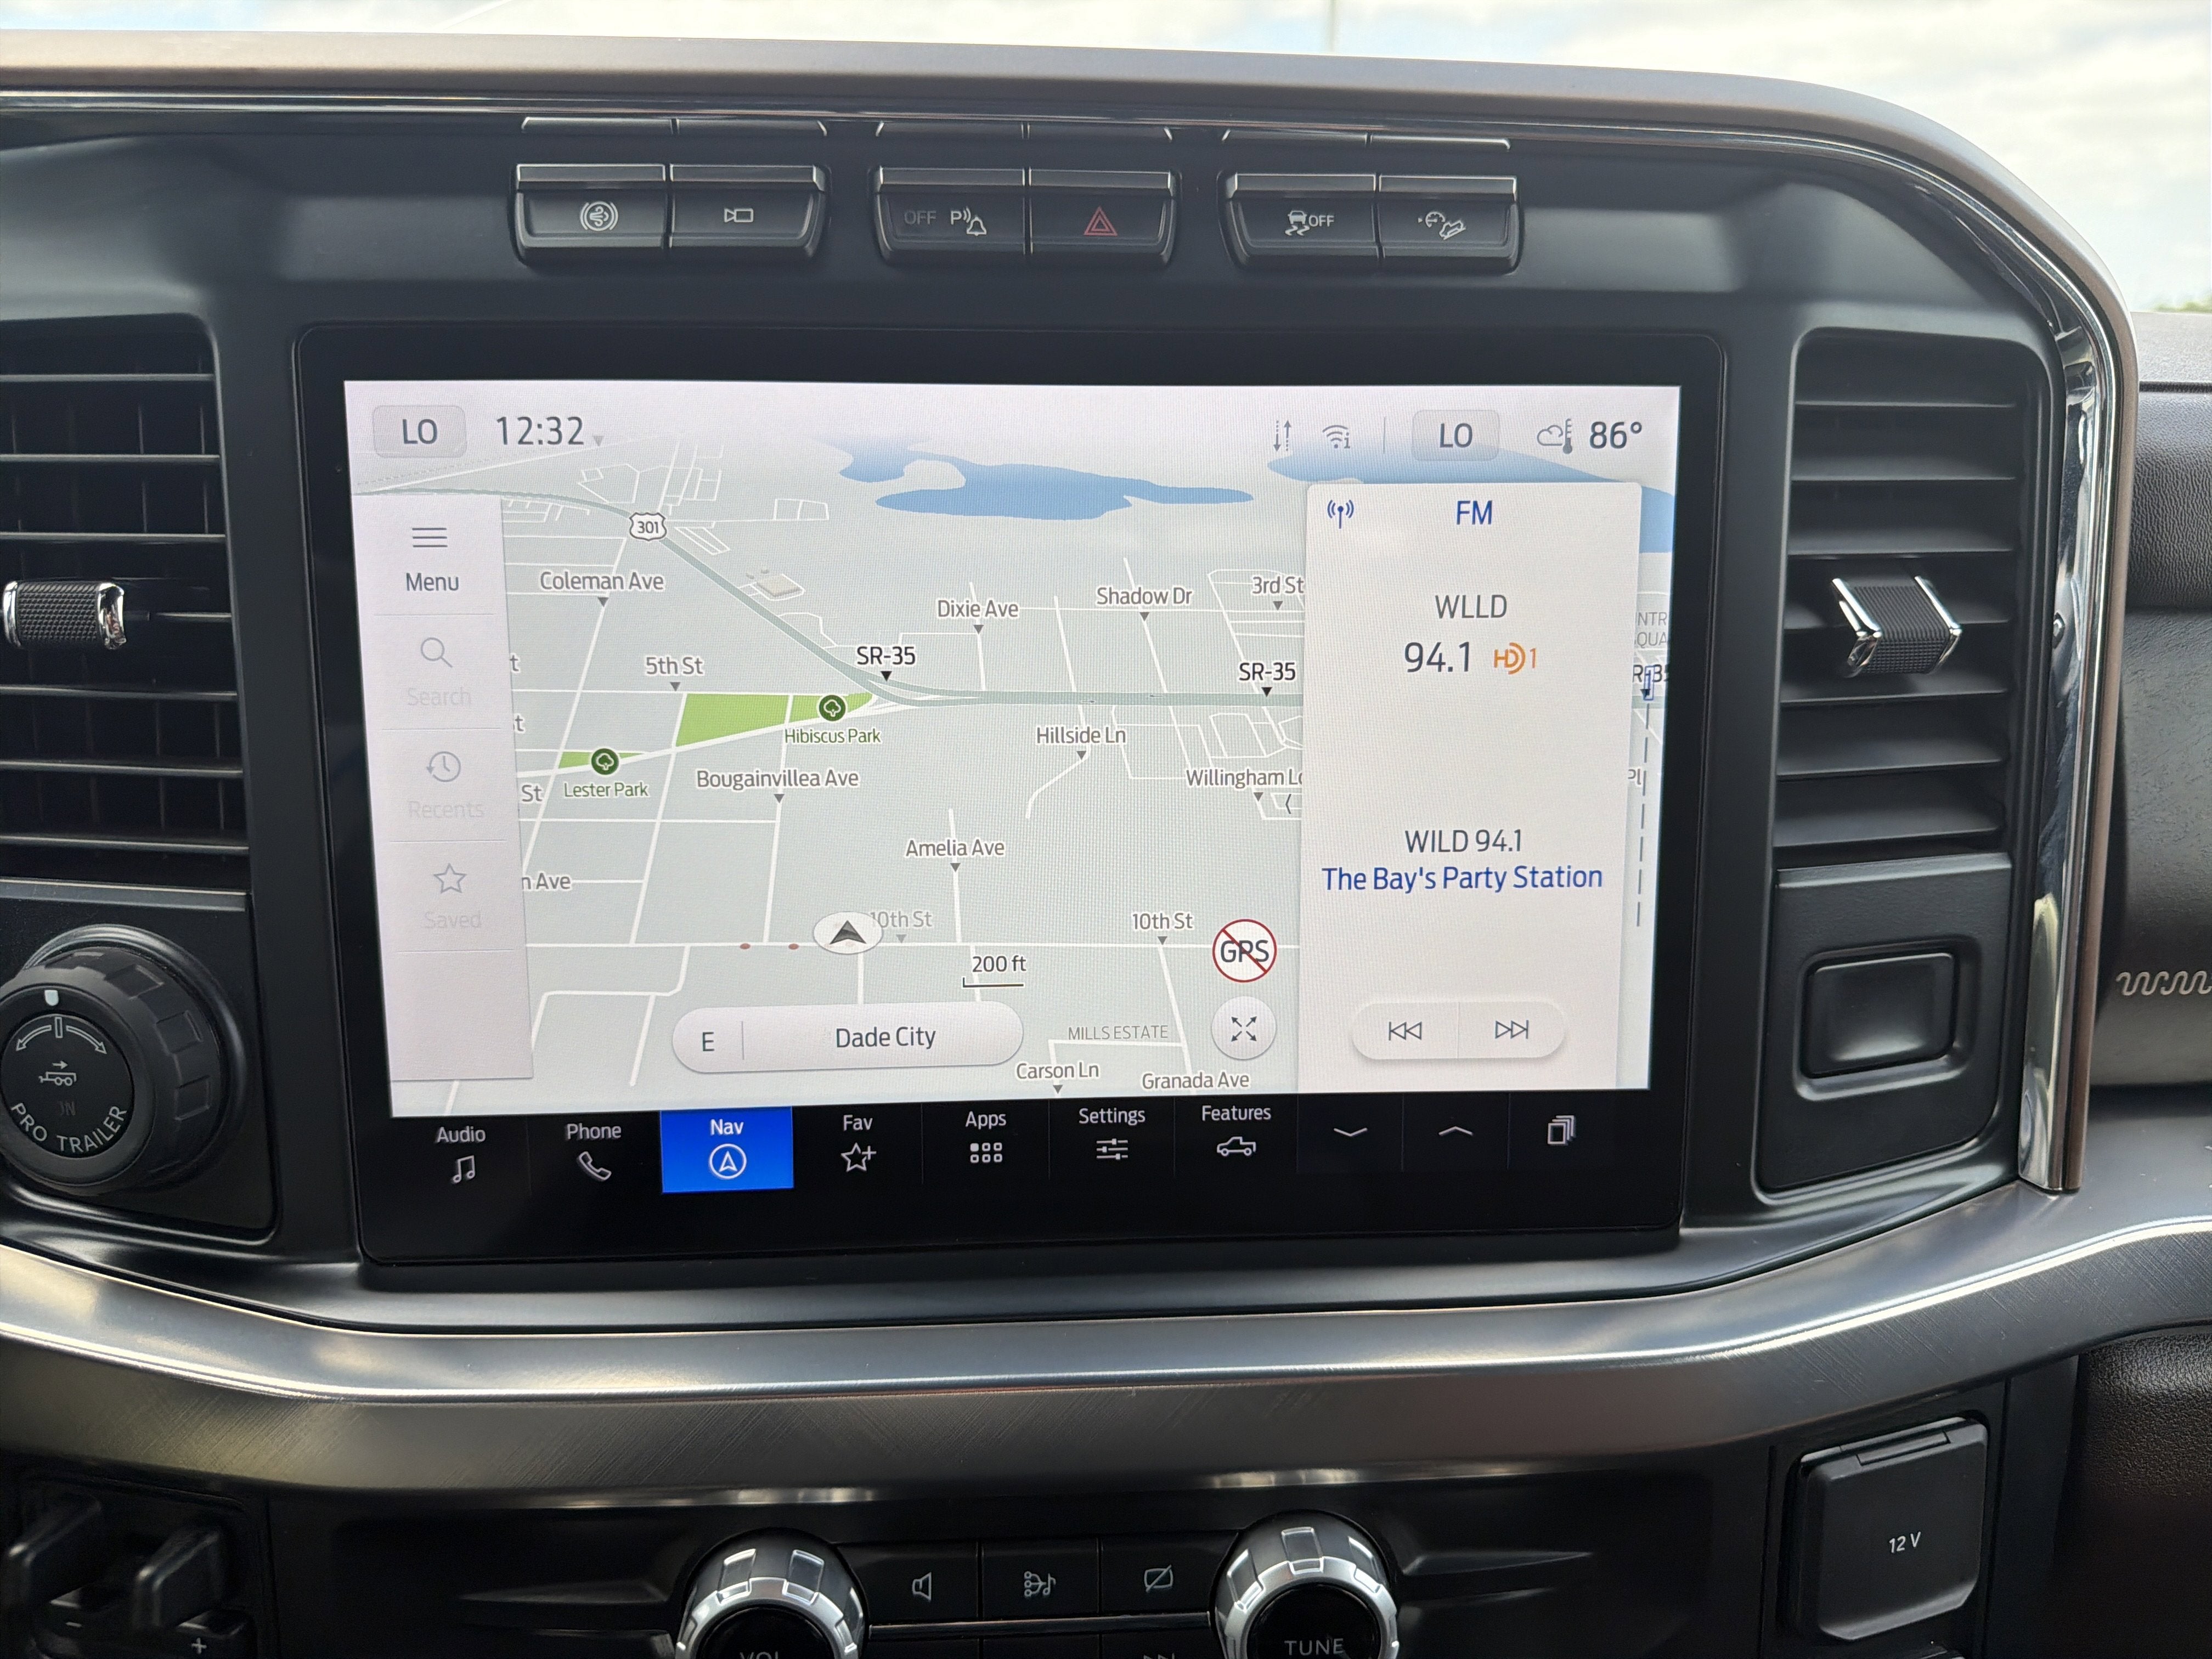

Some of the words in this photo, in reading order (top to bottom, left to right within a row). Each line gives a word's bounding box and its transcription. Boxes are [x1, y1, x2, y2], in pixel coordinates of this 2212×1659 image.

[903, 208, 937, 226] OFF
[1308, 215, 1335, 228] OFF
[402, 419, 437, 444] LO
[496, 416, 584, 445] 12:32
[1440, 423, 1473, 448] LO
[1590, 421, 1642, 449] 86°
[1457, 500, 1492, 525] FM
[636, 520, 659, 534] 301
[406, 572, 459, 591] Menu
[540, 571, 624, 590] Coleman
[629, 572, 664, 590] Ave
[1253, 576, 1280, 594] 3rd
[1285, 576, 1304, 594] St
[1097, 586, 1169, 605] Shadow
[1173, 587, 1192, 604] Dr
[938, 600, 980, 617] Dixie
[985, 600, 1018, 617] Ave
[1435, 594, 1507, 619] WLLD
[1634, 631, 1666, 648] QUA
[857, 646, 916, 665] SR-35
[1404, 641, 1469, 673] 94.1
[646, 657, 678, 675] 5th
[682, 657, 703, 675] St
[1239, 662, 1296, 681] SR-35
[407, 686, 472, 707] Search
[785, 729, 845, 743] Hibiscus
[848, 728, 881, 743] Park
[1037, 726, 1101, 744] Hillside
[1105, 726, 1126, 743] Ln
[697, 769, 820, 791] Bougainvillea
[825, 769, 859, 786] Ave
[1186, 769, 1284, 789] Willingham
[522, 785, 542, 802] St
[564, 783, 611, 797] Lester
[614, 782, 648, 797] Park
[409, 800, 485, 820] Recents
[906, 839, 967, 856] Amelia
[972, 839, 1005, 856] Ave
[1404, 830, 1469, 853] WILD
[1476, 829, 1521, 852] 94.1
[536, 872, 571, 889] Ave
[1322, 867, 1367, 890] The
[1374, 867, 1436, 894] Bay's
[1443, 866, 1507, 893] Party
[1513, 865, 1602, 888] Station
[424, 911, 481, 929] Saved
[913, 911, 932, 927] St
[1133, 913, 1170, 930] 10th
[1174, 912, 1193, 929] St
[1219, 939, 1269, 963] GPS
[972, 956, 1007, 973] 200
[1012, 955, 1026, 972] ft
[836, 1026, 890, 1048] Dade
[896, 1026, 936, 1049] City
[1067, 1026, 1111, 1040] MILLS
[1114, 1024, 1169, 1040] ESTATE
[702, 1031, 714, 1052] E
[1017, 1063, 1074, 1079] Carson
[1079, 1062, 1099, 1077] Ln
[1142, 1072, 1214, 1090] Granada
[1217, 1071, 1249, 1087] Ave
[966, 1111, 1007, 1130] Apps
[1079, 1108, 1146, 1126] Settings
[1202, 1105, 1271, 1121] Features
[11, 1103, 48, 1142] PRO
[57, 1105, 127, 1153] TRAILER
[567, 1122, 622, 1139] Phone
[710, 1118, 744, 1136] Nav
[843, 1114, 873, 1131] Fav
[436, 1126, 486, 1143] Audio
[1889, 1536, 1906, 1553] 12
[1910, 1531, 1921, 1548] V
[1284, 1638, 1344, 1656] TUNE
